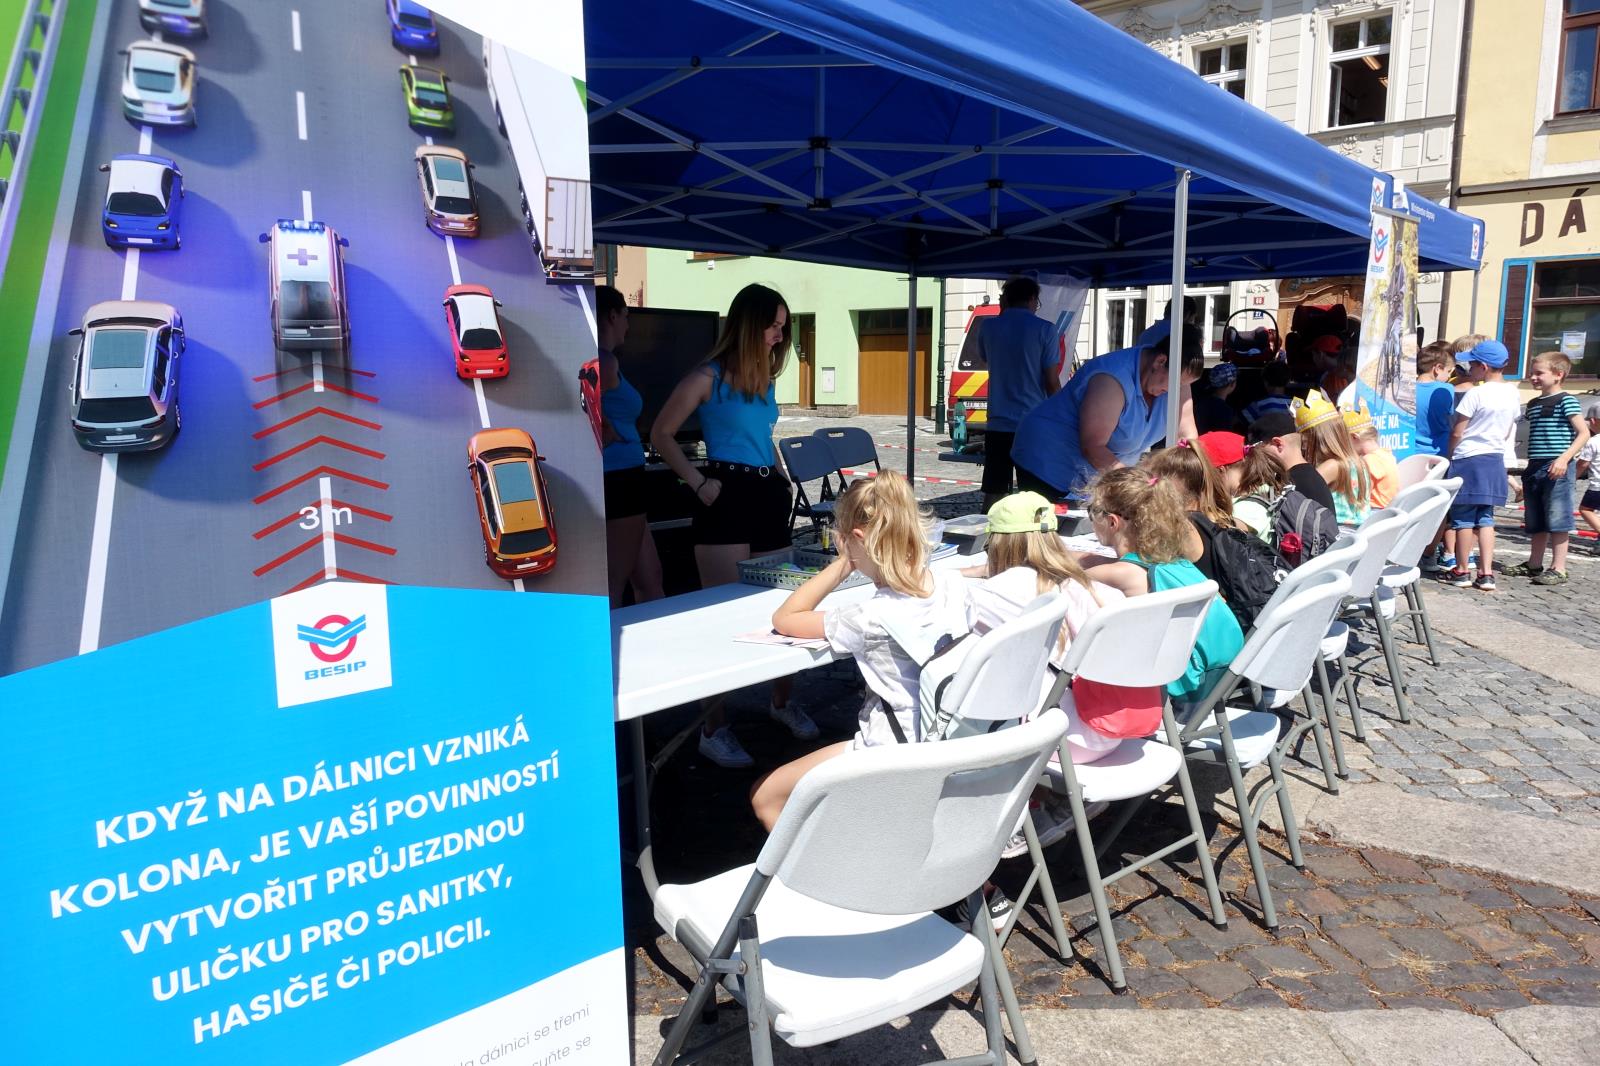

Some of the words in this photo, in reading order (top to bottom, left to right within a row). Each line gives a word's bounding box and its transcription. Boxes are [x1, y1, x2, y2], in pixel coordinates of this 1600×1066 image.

[1388, 413, 1399, 429] NA
[304, 660, 366, 681] BESIP
[50, 847, 241, 918] KOLONA,
[250, 830, 291, 863] JE
[297, 798, 378, 848] VAŠÍ
[386, 750, 559, 825] POVINNOSTÍ
[96, 788, 209, 848] KDYŽ
[217, 782, 275, 817] NA
[283, 748, 416, 802] DÁLNICI
[422, 714, 530, 766] VZNIKÁ
[120, 874, 318, 954] VYTVOŘIT
[326, 812, 525, 894] PRŮJEZDNOU
[151, 933, 292, 1002] ULIČKU
[300, 910, 370, 954] PRO
[376, 863, 512, 926] SANITKY,
[193, 972, 329, 1044] HASIČE
[336, 956, 370, 989] ČI
[378, 917, 491, 976] POLICII.
[479, 1032, 530, 1065] dálnici
[534, 1025, 550, 1040] se
[554, 1004, 590, 1031] třemi
[575, 1035, 591, 1051] se
